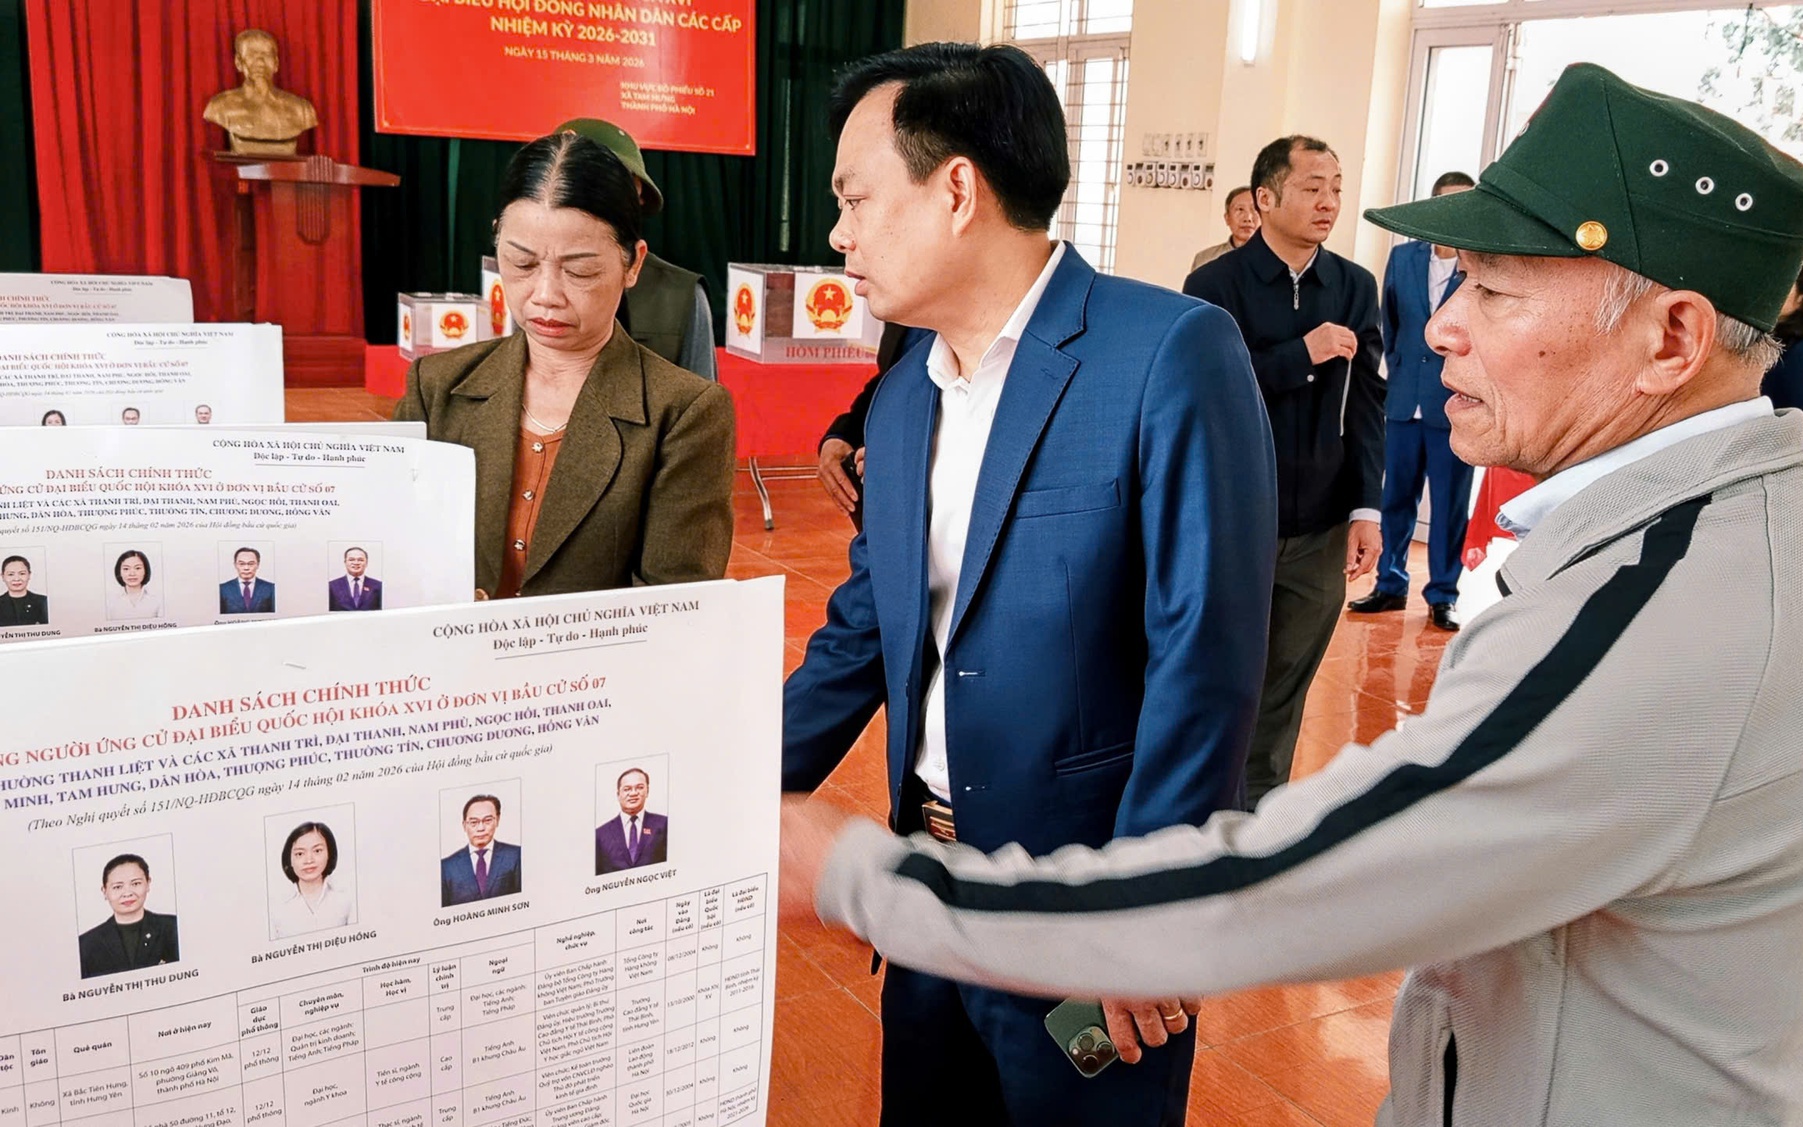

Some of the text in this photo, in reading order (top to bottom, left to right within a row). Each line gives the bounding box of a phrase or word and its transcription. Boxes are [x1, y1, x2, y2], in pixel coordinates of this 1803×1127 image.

[490, 16, 656, 46] NHIỆM KỲ 2026-2031
[588, 3, 637, 22] NHÂN
[640, 8, 676, 26] DÂN
[678, 11, 709, 30] CÁC
[711, 14, 742, 32] CẤP
[432, 600, 698, 639] CỘNG HÒA XÃ HỘI CHỦ NGHĨA VIỆT NAM
[493, 623, 648, 651] Độc lập Tự do Hạnh phúc
[172, 674, 430, 721] DANH SÁCH CHÍNH THỨC
[25, 741, 90, 764] NGƯỜI
[96, 736, 136, 754] ỨNG
[142, 728, 168, 748] CỬ
[172, 727, 204, 745] ĐẠI
[210, 716, 251, 738] BIỂU
[256, 709, 308, 734] QUỐC
[313, 707, 344, 726] HỘI
[350, 701, 398, 720] KHÓA
[404, 699, 432, 714] XVI
[436, 694, 449, 710] Ở
[453, 692, 486, 708] ĐƠN
[491, 690, 506, 705] VỊ
[512, 682, 542, 700] BẦU
[546, 678, 566, 696] CỬ
[569, 673, 588, 692] SỐ
[592, 676, 606, 689] 07
[0, 774, 54, 791] HƯỜNG
[251, 930, 376, 964] Bà NGUYỄN THỊ DIỆU HỒNG
[62, 968, 198, 1002] Bà NGUYỄN THỊ THU DUNG
